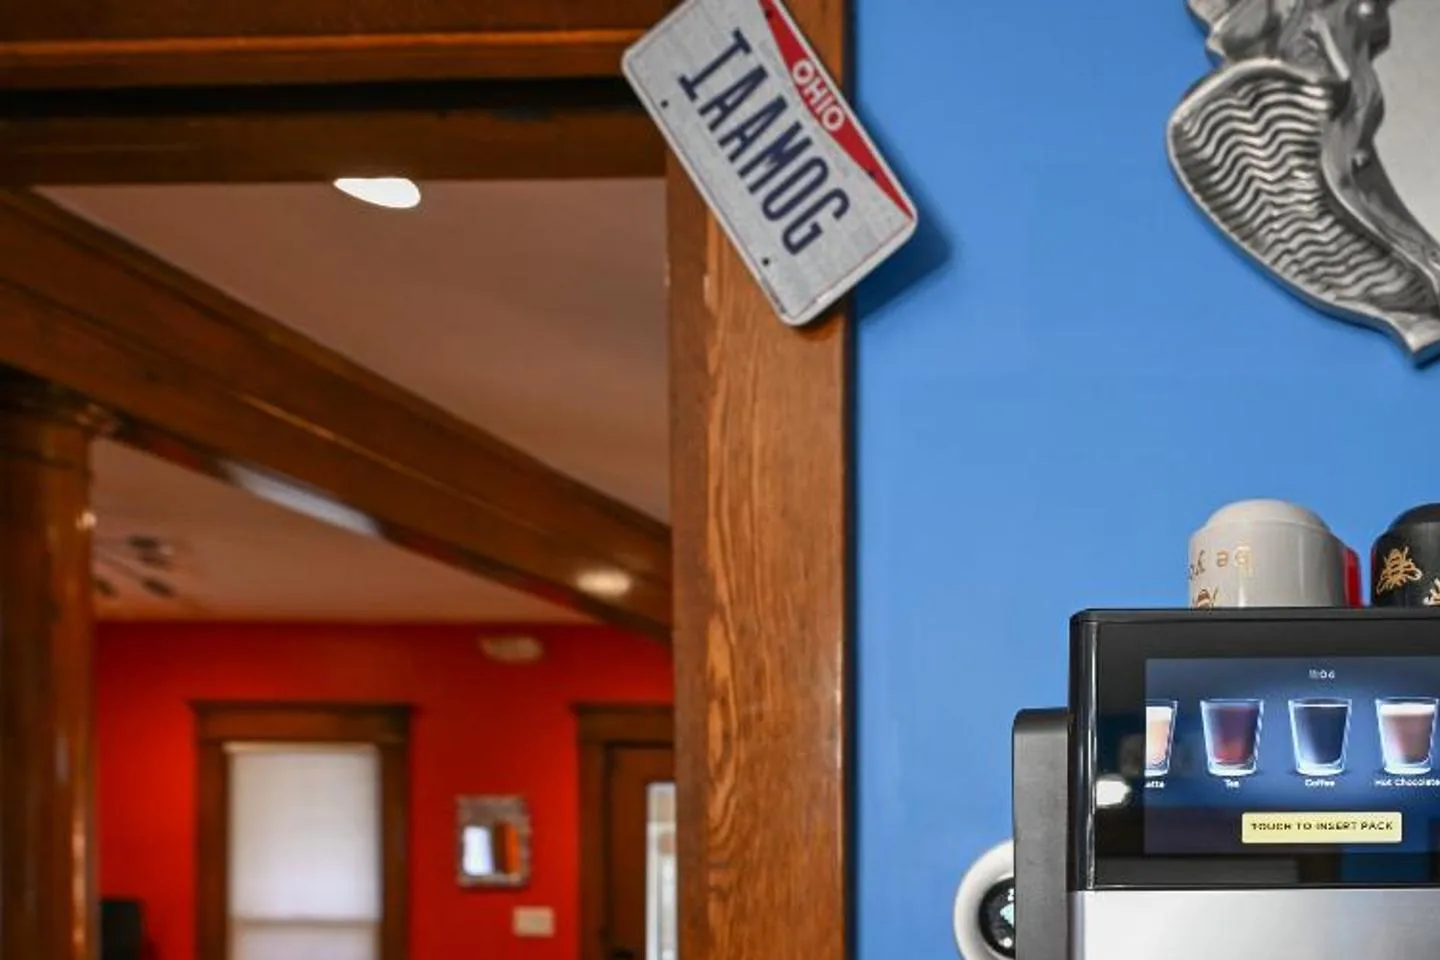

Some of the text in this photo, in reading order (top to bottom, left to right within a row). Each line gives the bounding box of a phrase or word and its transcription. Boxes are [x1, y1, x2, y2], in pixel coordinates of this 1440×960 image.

[792, 60, 845, 131] OHIO
[678, 27, 850, 256] IAAMOG
[1145, 779, 1165, 788] atte
[1224, 778, 1240, 789] Tea
[1305, 778, 1336, 788] Coffee
[1375, 777, 1440, 787] Hot Chocolate
[1251, 821, 1393, 831] TOUCH TO INSERT PACK
